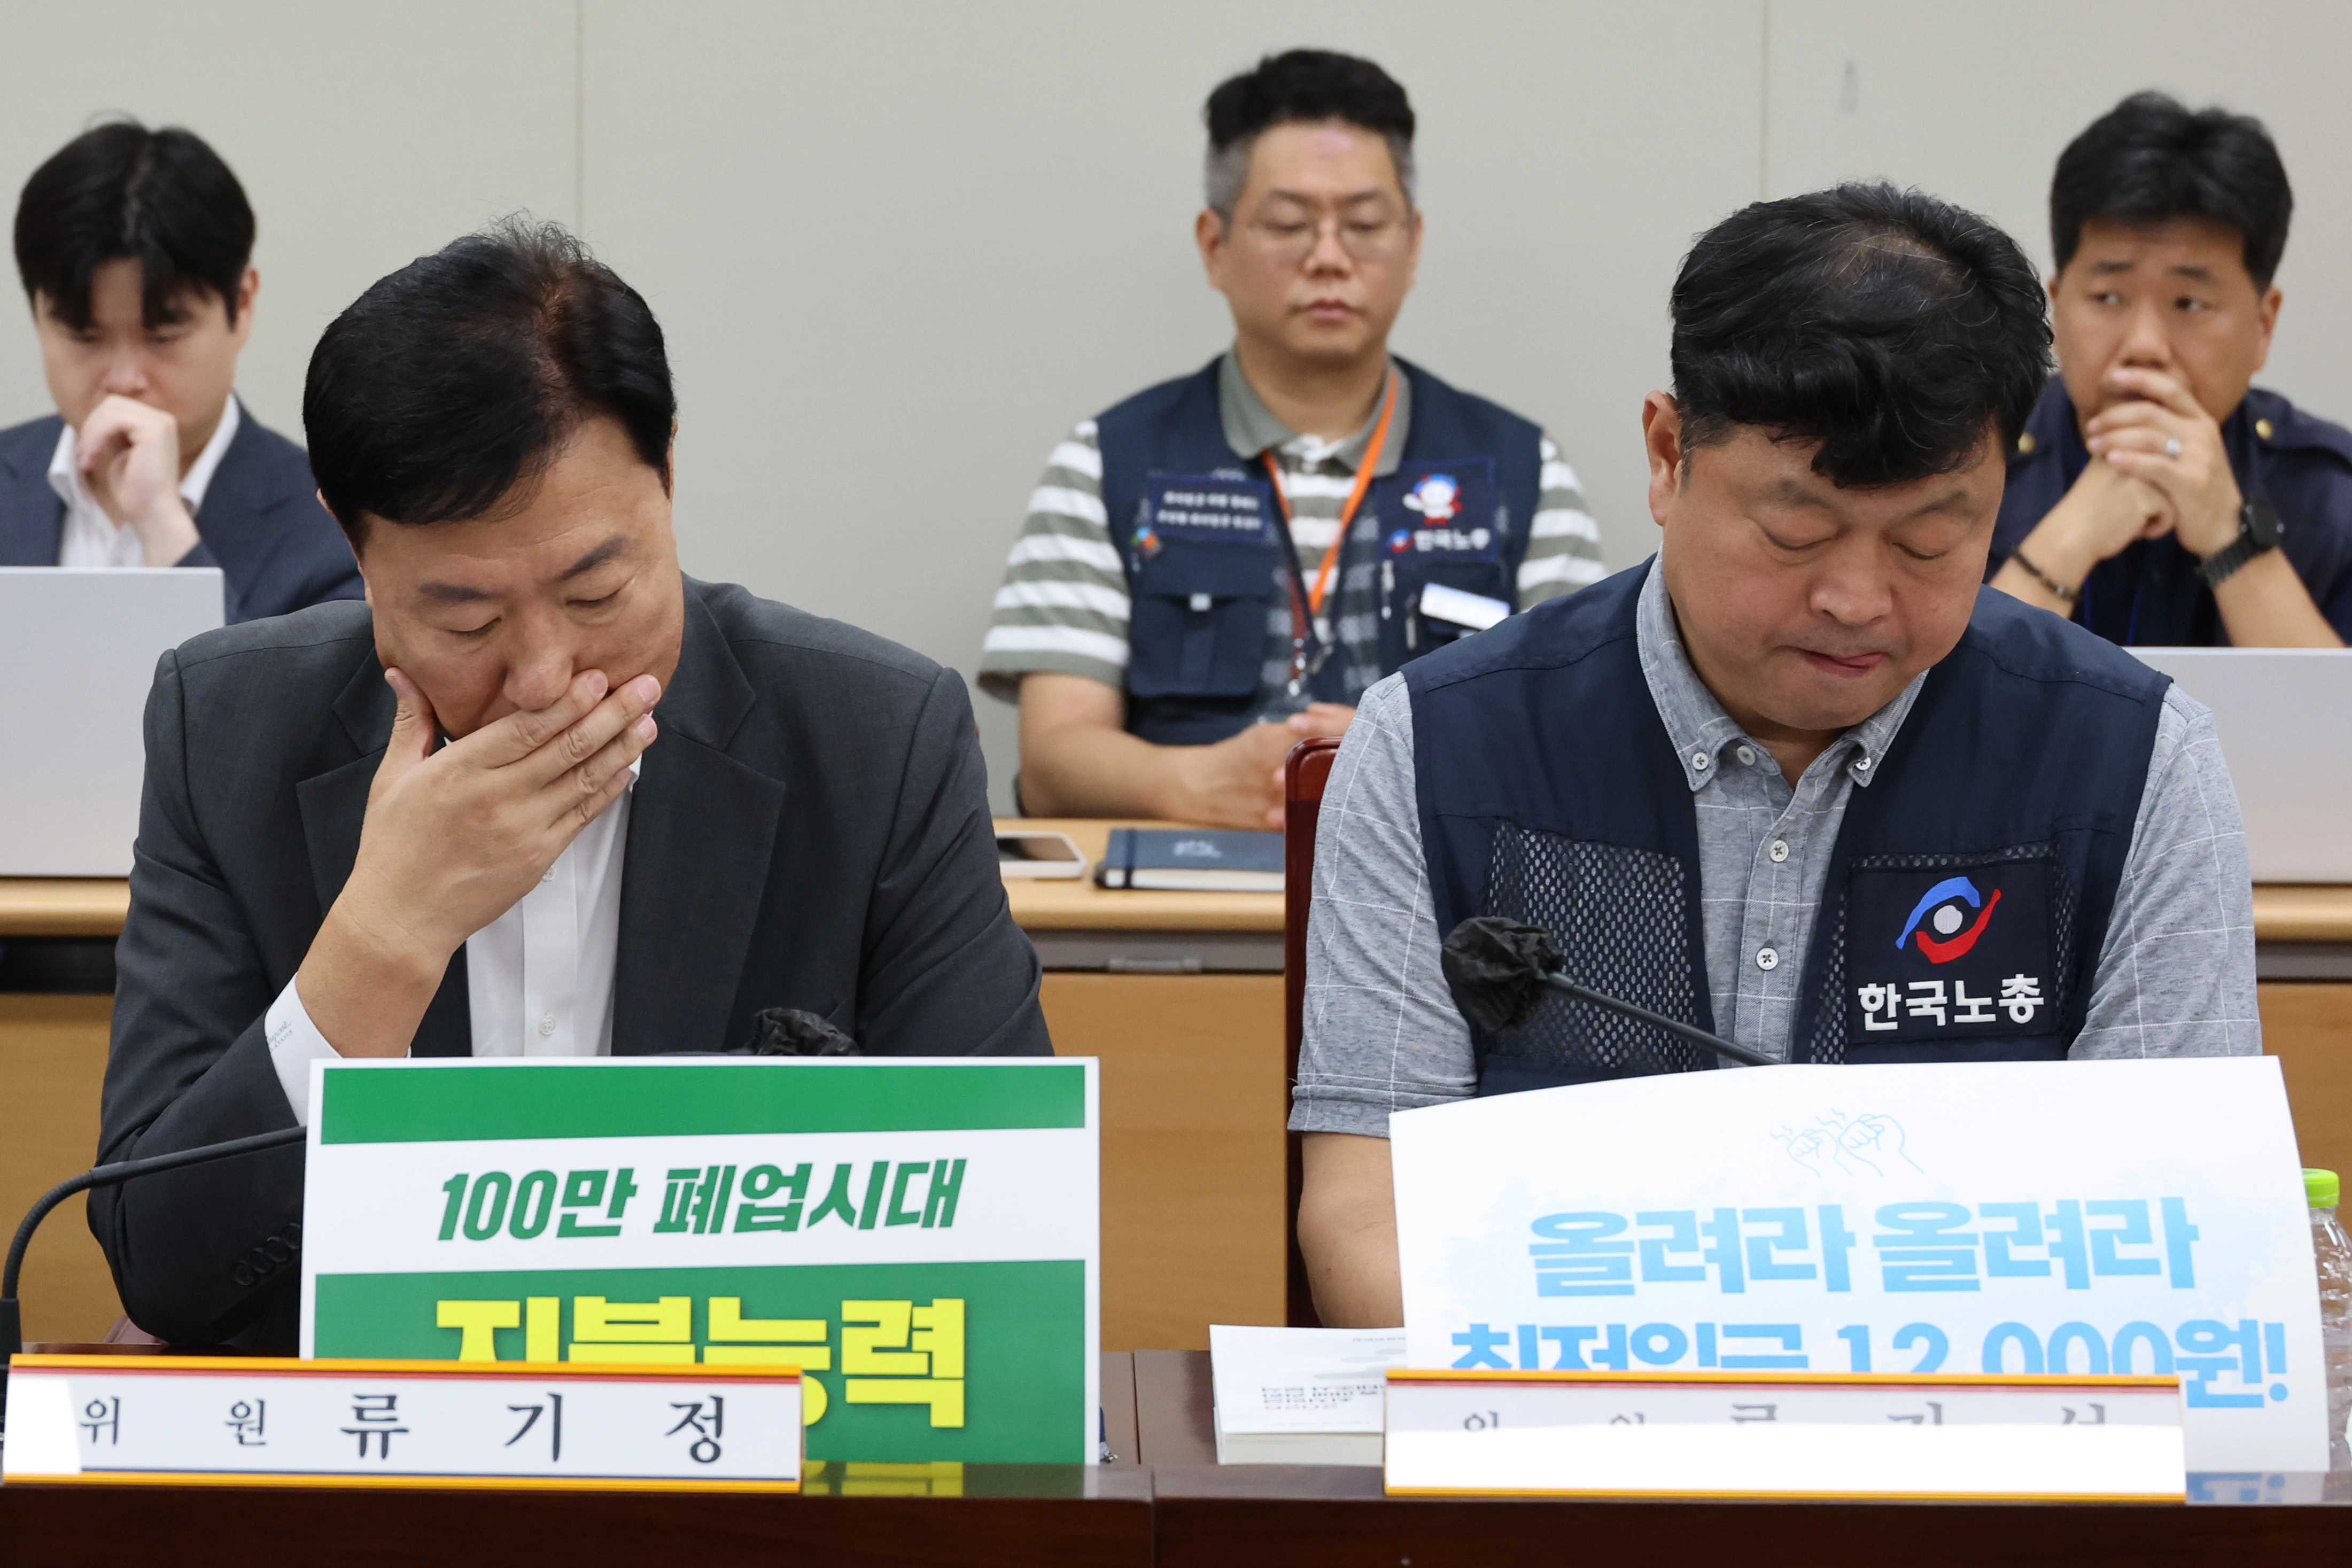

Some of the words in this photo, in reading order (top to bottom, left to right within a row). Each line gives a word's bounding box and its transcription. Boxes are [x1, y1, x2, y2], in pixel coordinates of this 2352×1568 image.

[1858, 974, 2044, 1031] 한국노총
[438, 1167, 638, 1240] 100만
[653, 1159, 967, 1235] 폐업시대
[1528, 1205, 1856, 1297] 올려라
[1872, 1197, 2199, 1292] 올려라
[1837, 1319, 2288, 1408] 12000원!
